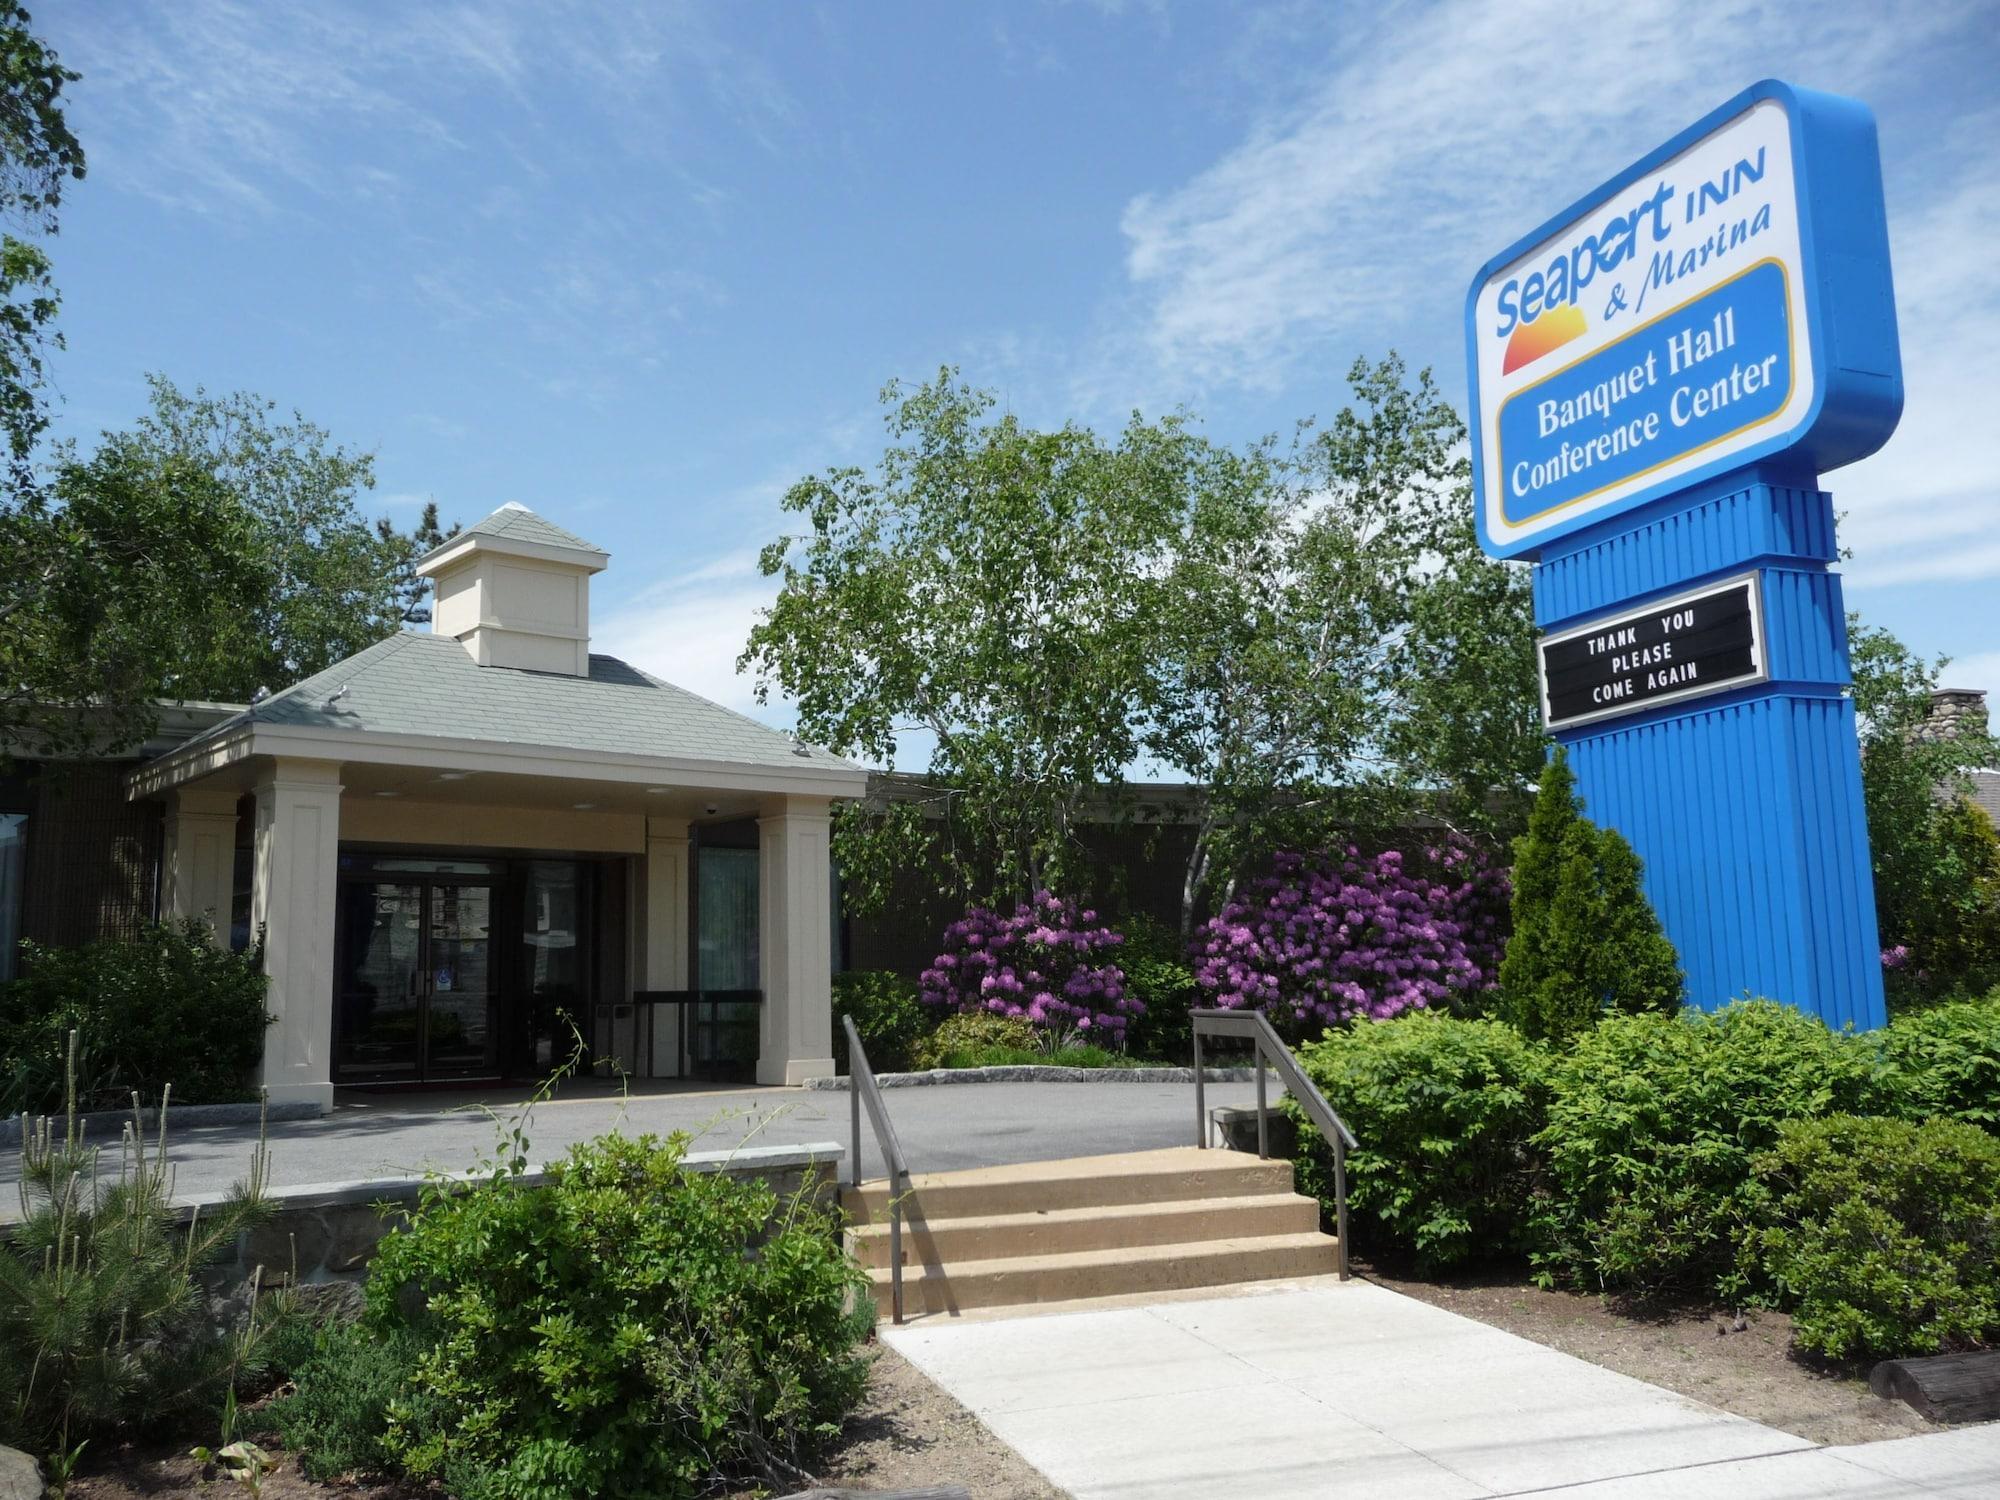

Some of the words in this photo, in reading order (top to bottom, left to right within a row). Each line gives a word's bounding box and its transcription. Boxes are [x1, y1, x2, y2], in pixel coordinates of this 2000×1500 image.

[1685, 146, 1765, 223] INN
[1604, 282, 1628, 321] &
[1636, 203, 1771, 313] Marina
[1537, 350, 1656, 438] Banquet
[1667, 306, 1735, 375] Hall
[1512, 414, 1659, 497] Conference
[1670, 354, 1777, 426] Center
[1588, 627, 1636, 655] THANK
[1661, 609, 1694, 633] YOU
[1612, 642, 1672, 673] PLEASE
[1593, 678, 1634, 702] COME
[1648, 662, 1697, 689] AGAIN
